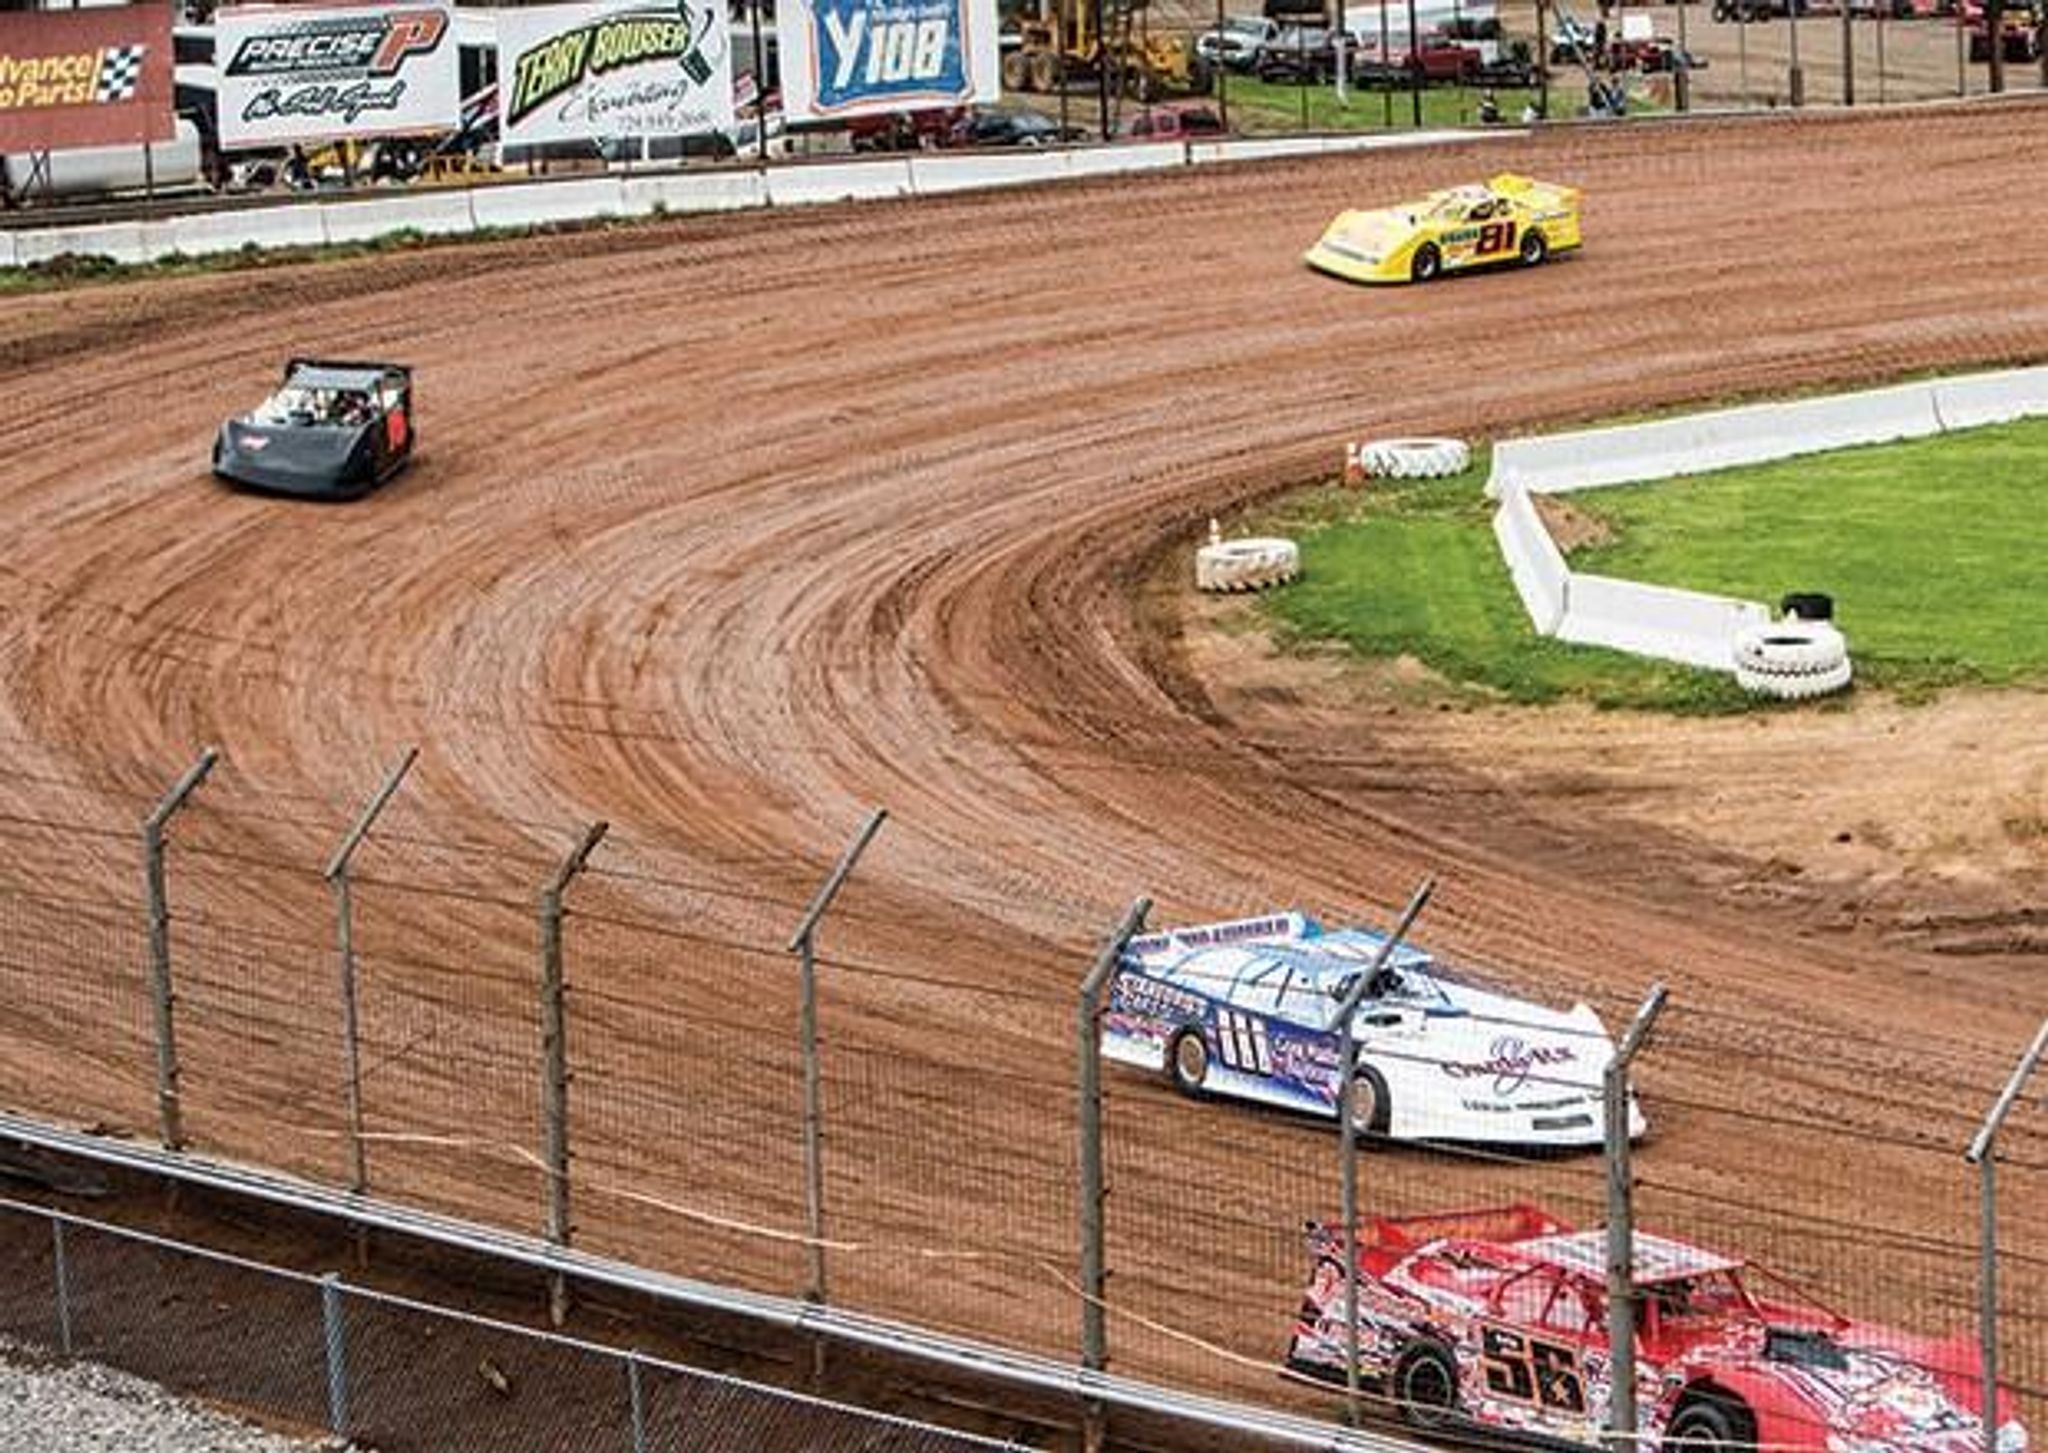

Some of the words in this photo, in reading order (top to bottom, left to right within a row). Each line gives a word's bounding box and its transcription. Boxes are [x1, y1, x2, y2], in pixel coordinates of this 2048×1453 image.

[238, 31, 382, 64] PRECISE
[510, 28, 593, 121] TERRY
[591, 21, 690, 71] BOWSER
[823, 9, 949, 91] Y108
[16, 80, 87, 107] Parts
[1475, 221, 1517, 256] 81
[1217, 1008, 1271, 1077] 111
